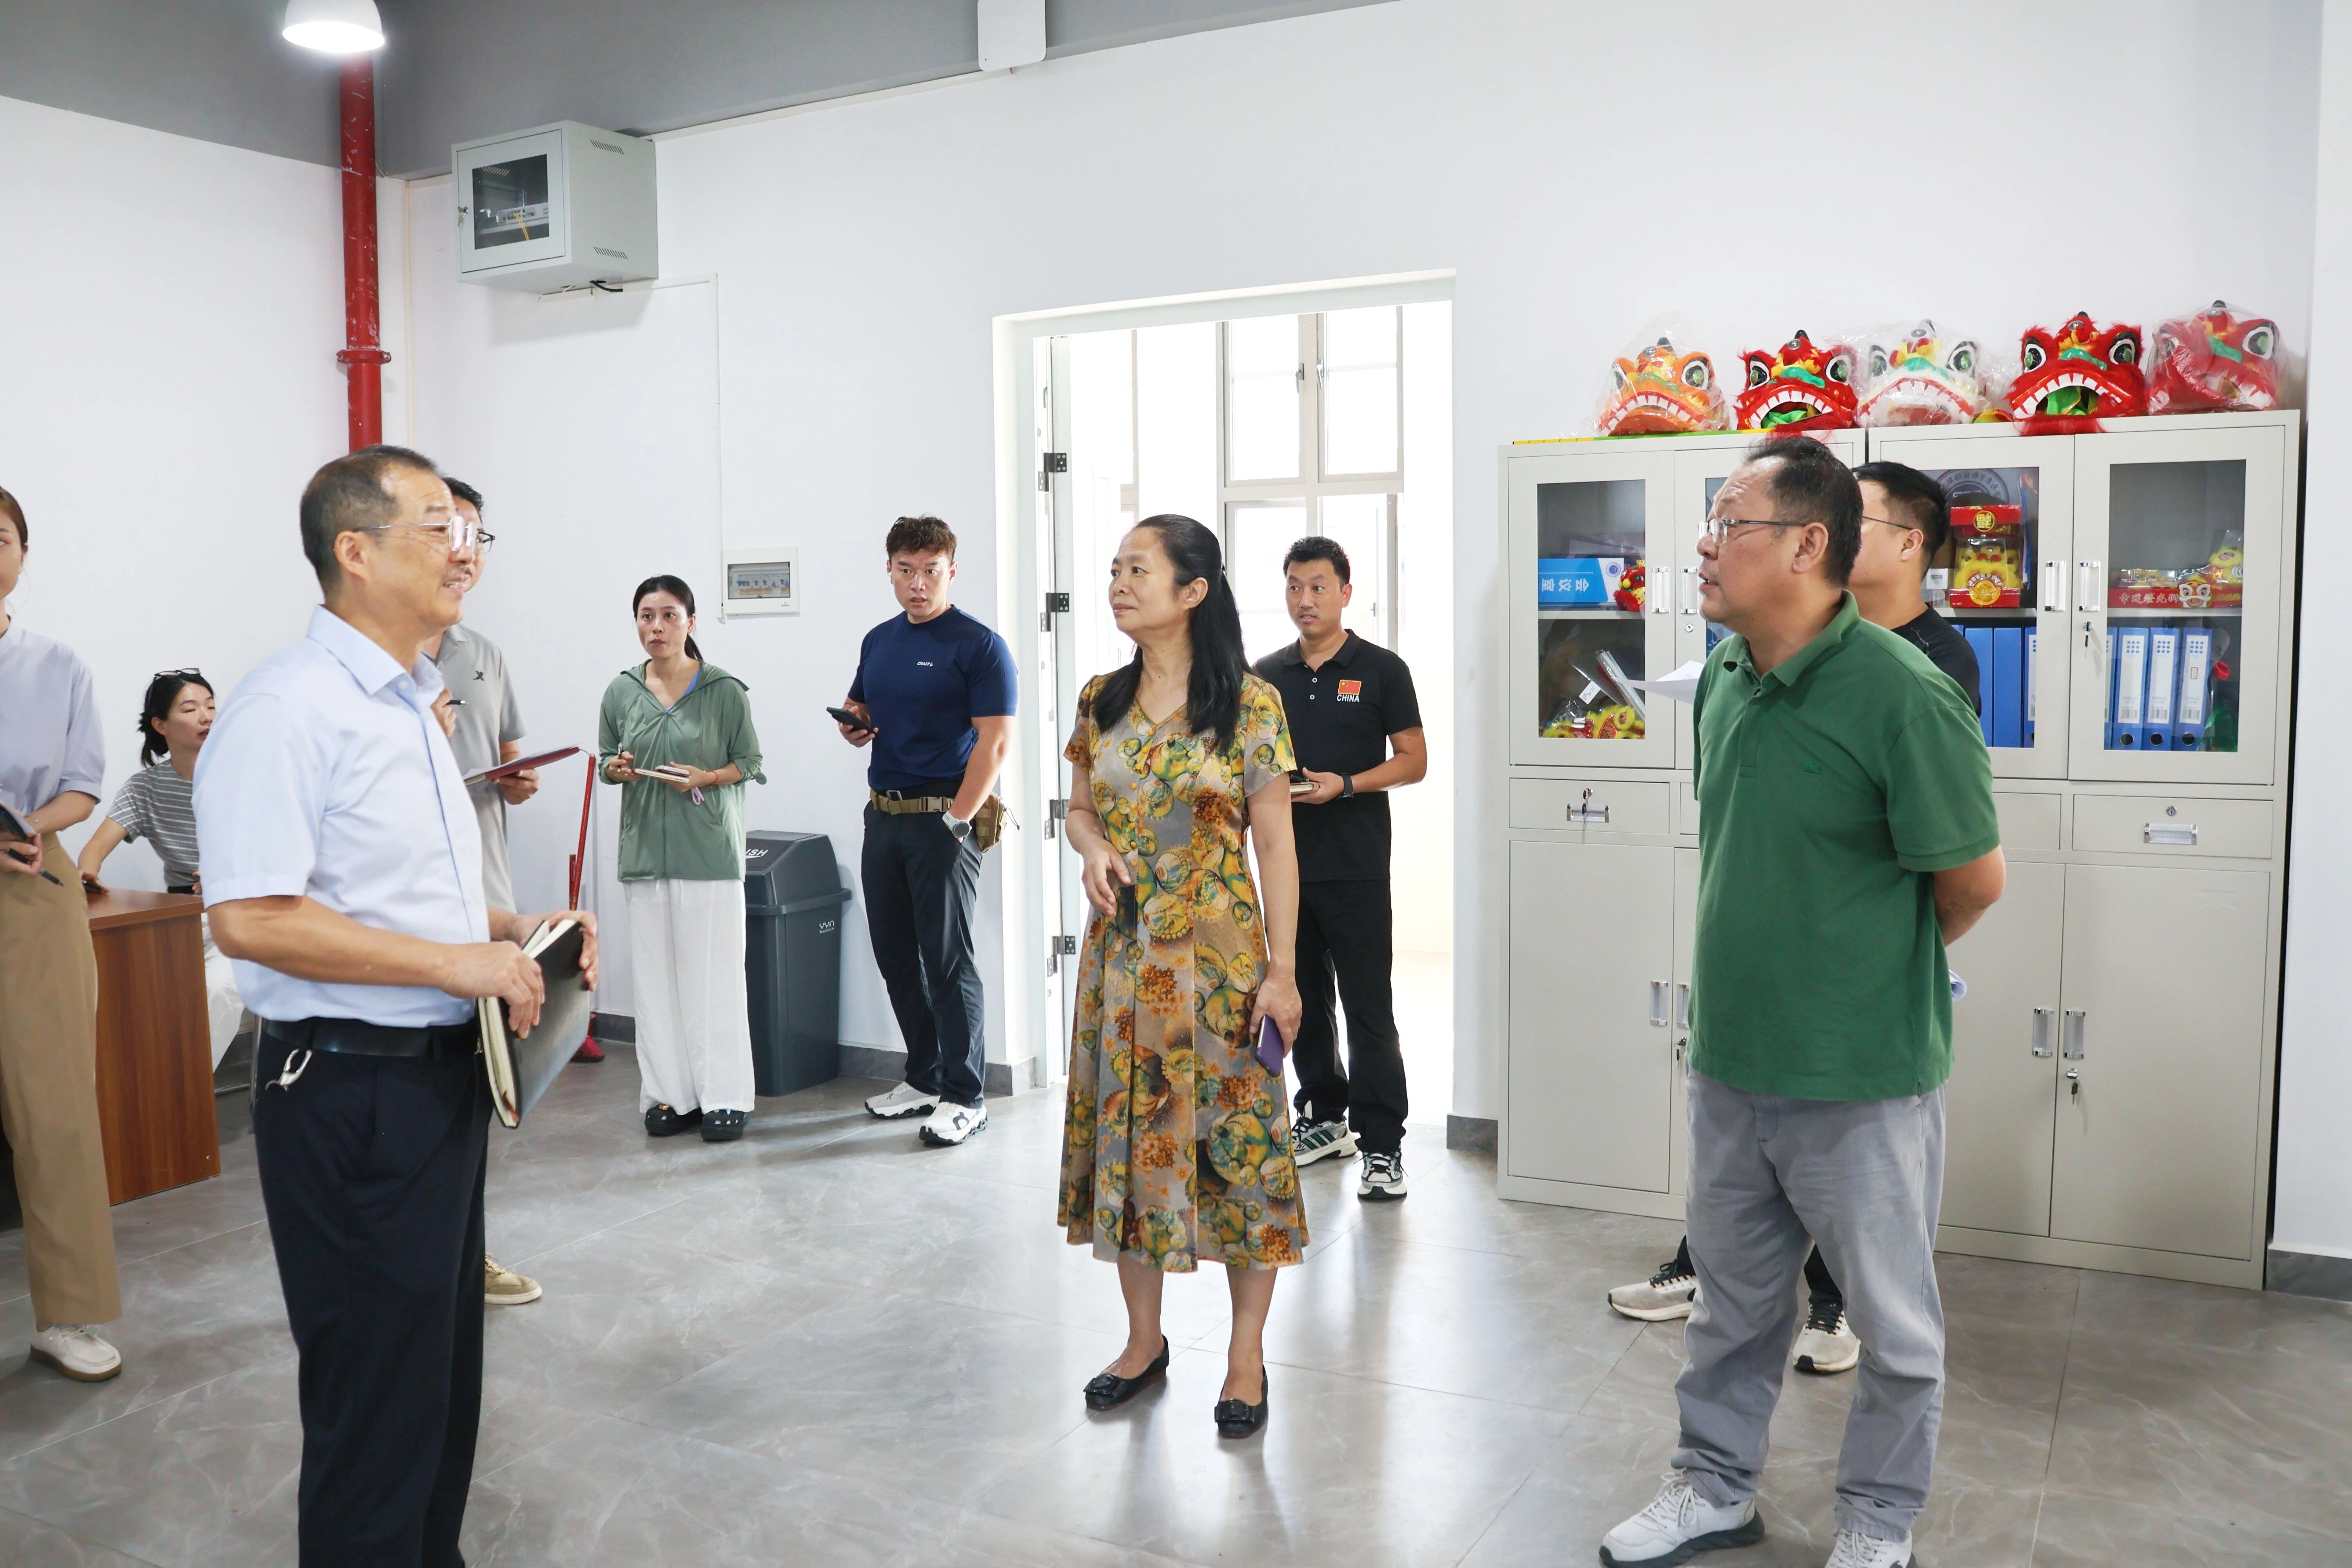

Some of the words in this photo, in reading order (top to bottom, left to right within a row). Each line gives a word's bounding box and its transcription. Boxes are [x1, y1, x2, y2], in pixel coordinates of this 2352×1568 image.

[1541, 578, 1590, 592] 会议室
[1337, 694, 1359, 702] CHINA
